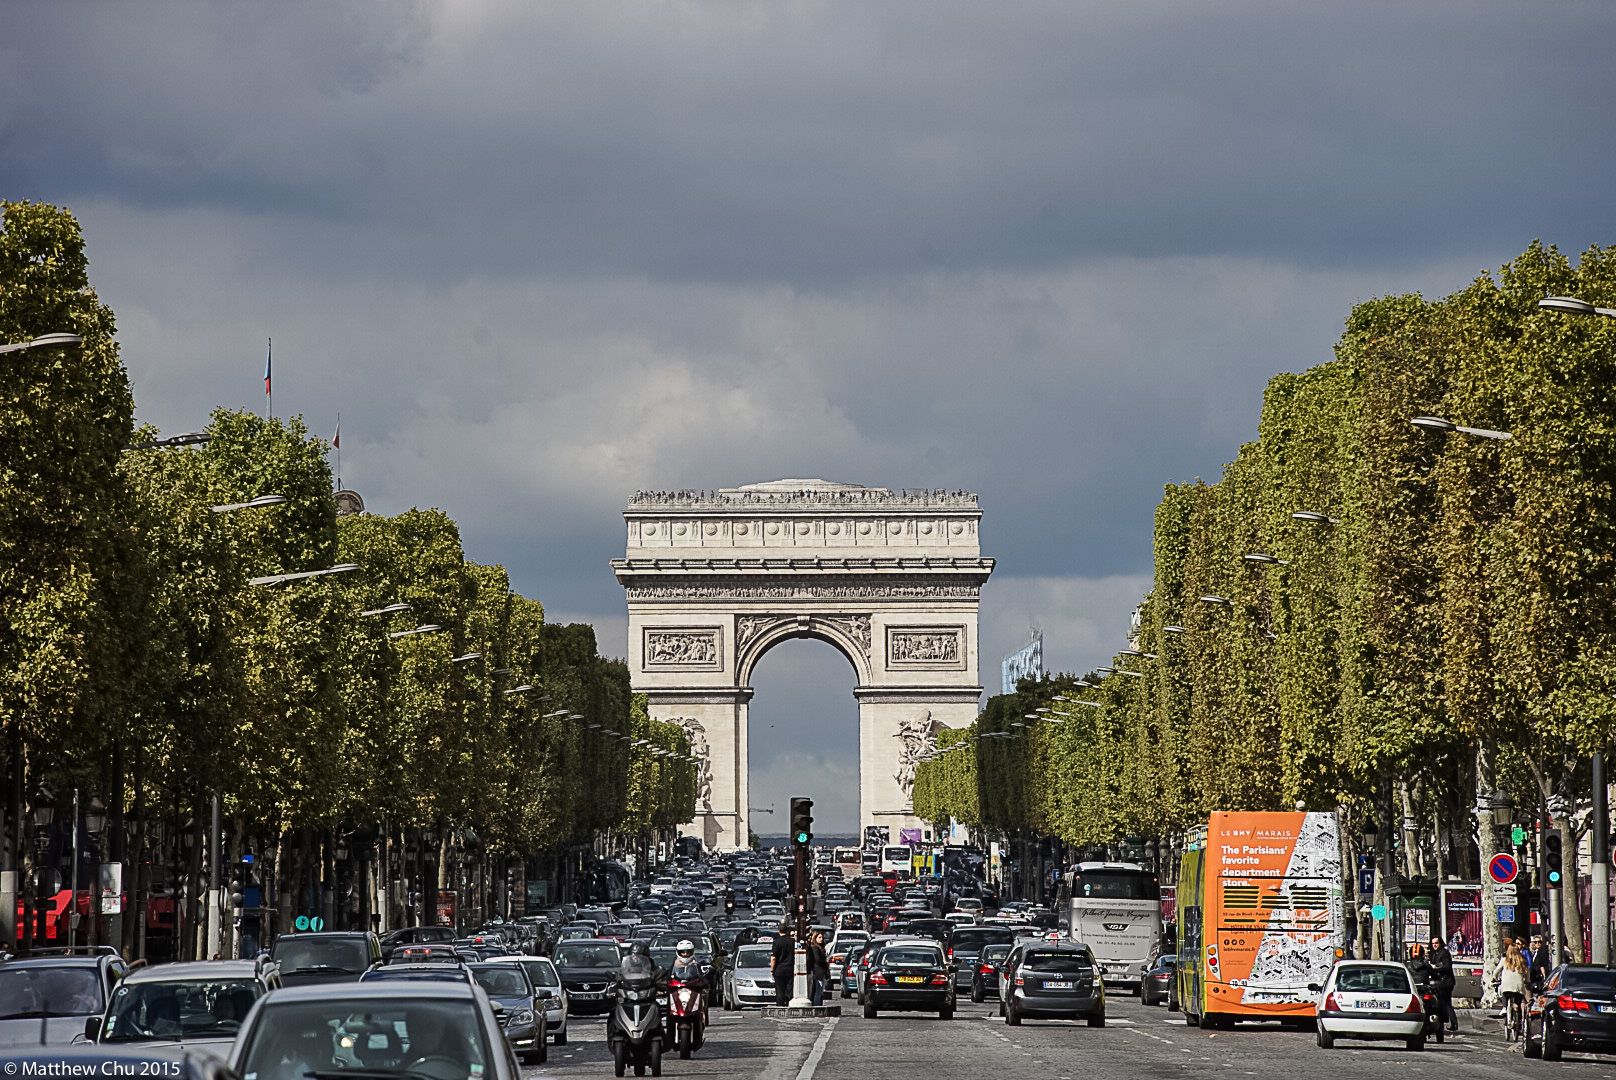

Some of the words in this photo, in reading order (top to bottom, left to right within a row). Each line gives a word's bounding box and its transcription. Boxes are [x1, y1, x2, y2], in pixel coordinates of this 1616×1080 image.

[1221, 845, 1240, 855] The
[1221, 855, 1260, 865] favorite
[1222, 867, 1281, 877] department
[1364, 874, 1373, 890] P
